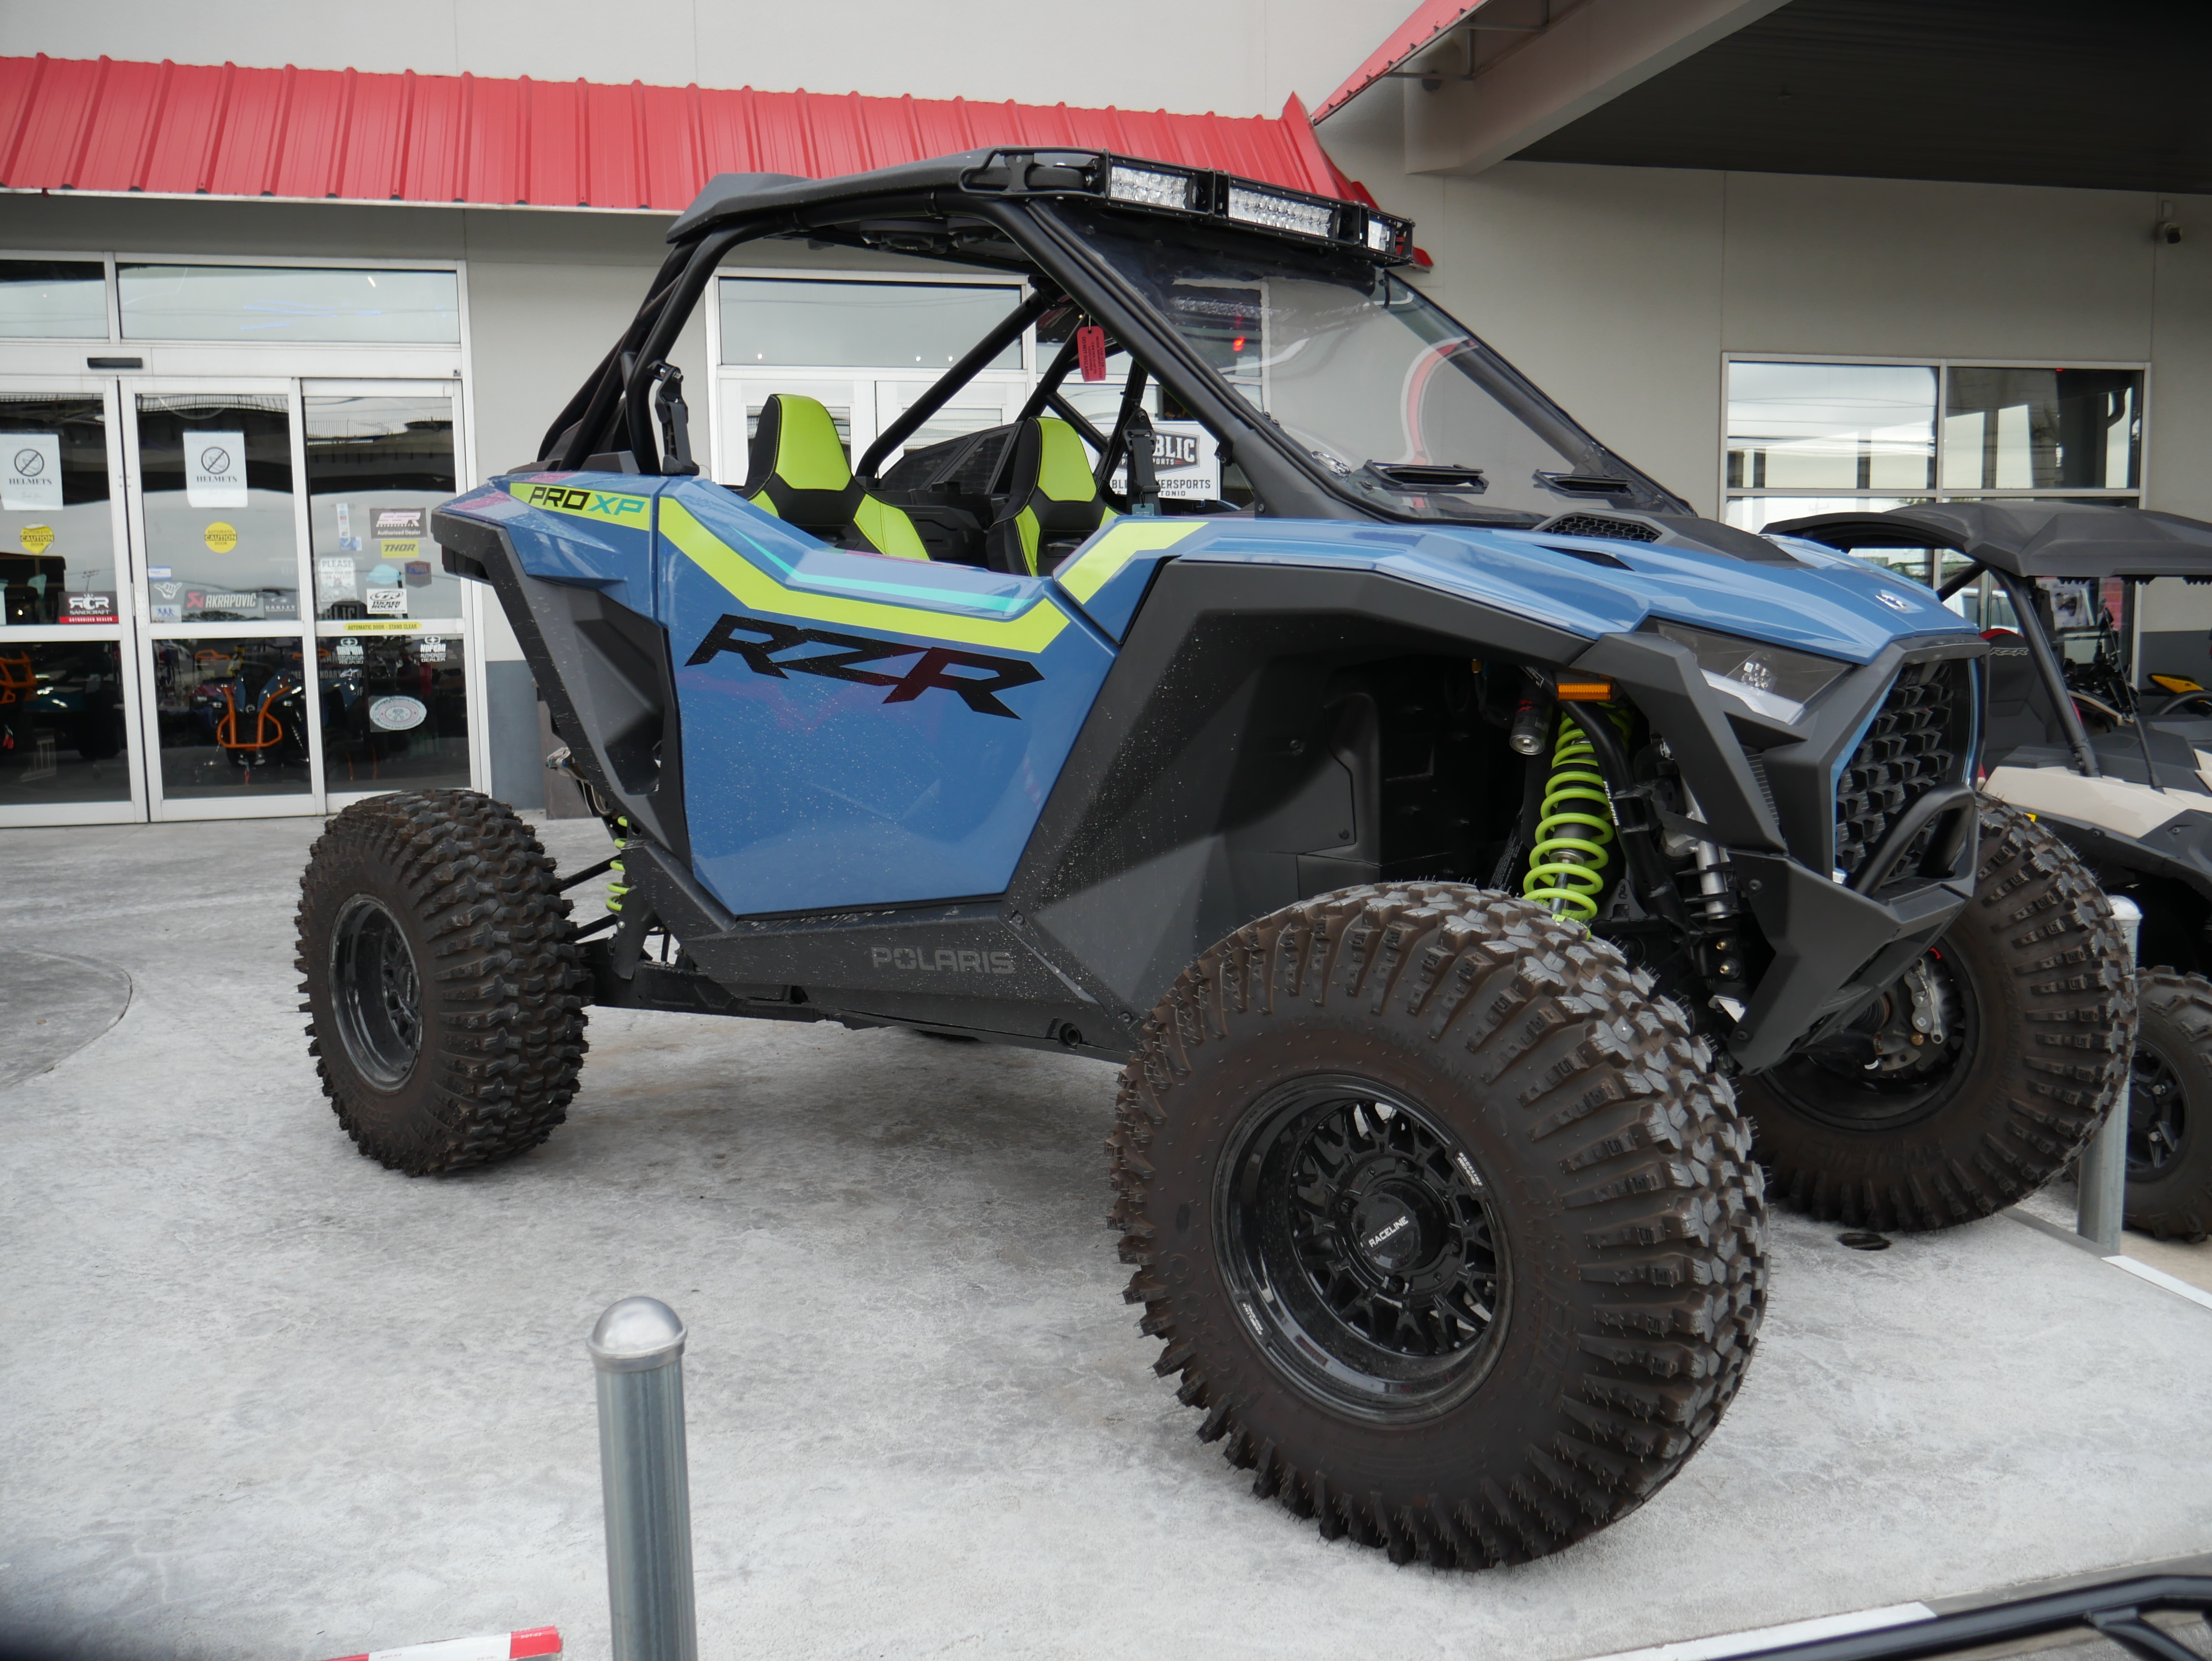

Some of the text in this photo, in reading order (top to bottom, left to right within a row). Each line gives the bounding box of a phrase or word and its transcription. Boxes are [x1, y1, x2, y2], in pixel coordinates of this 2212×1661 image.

[528, 486, 646, 515] PRO XP
[376, 512, 421, 527] SSR
[384, 544, 416, 552] THOR
[1989, 647, 2028, 656] RZR
[685, 613, 1045, 720] RZR
[1603, 781, 1619, 826] POLARIS
[870, 945, 1014, 974] POLARIS
[1459, 1152, 1483, 1186] RACELINE
[1369, 1215, 1409, 1248] RACELINE
